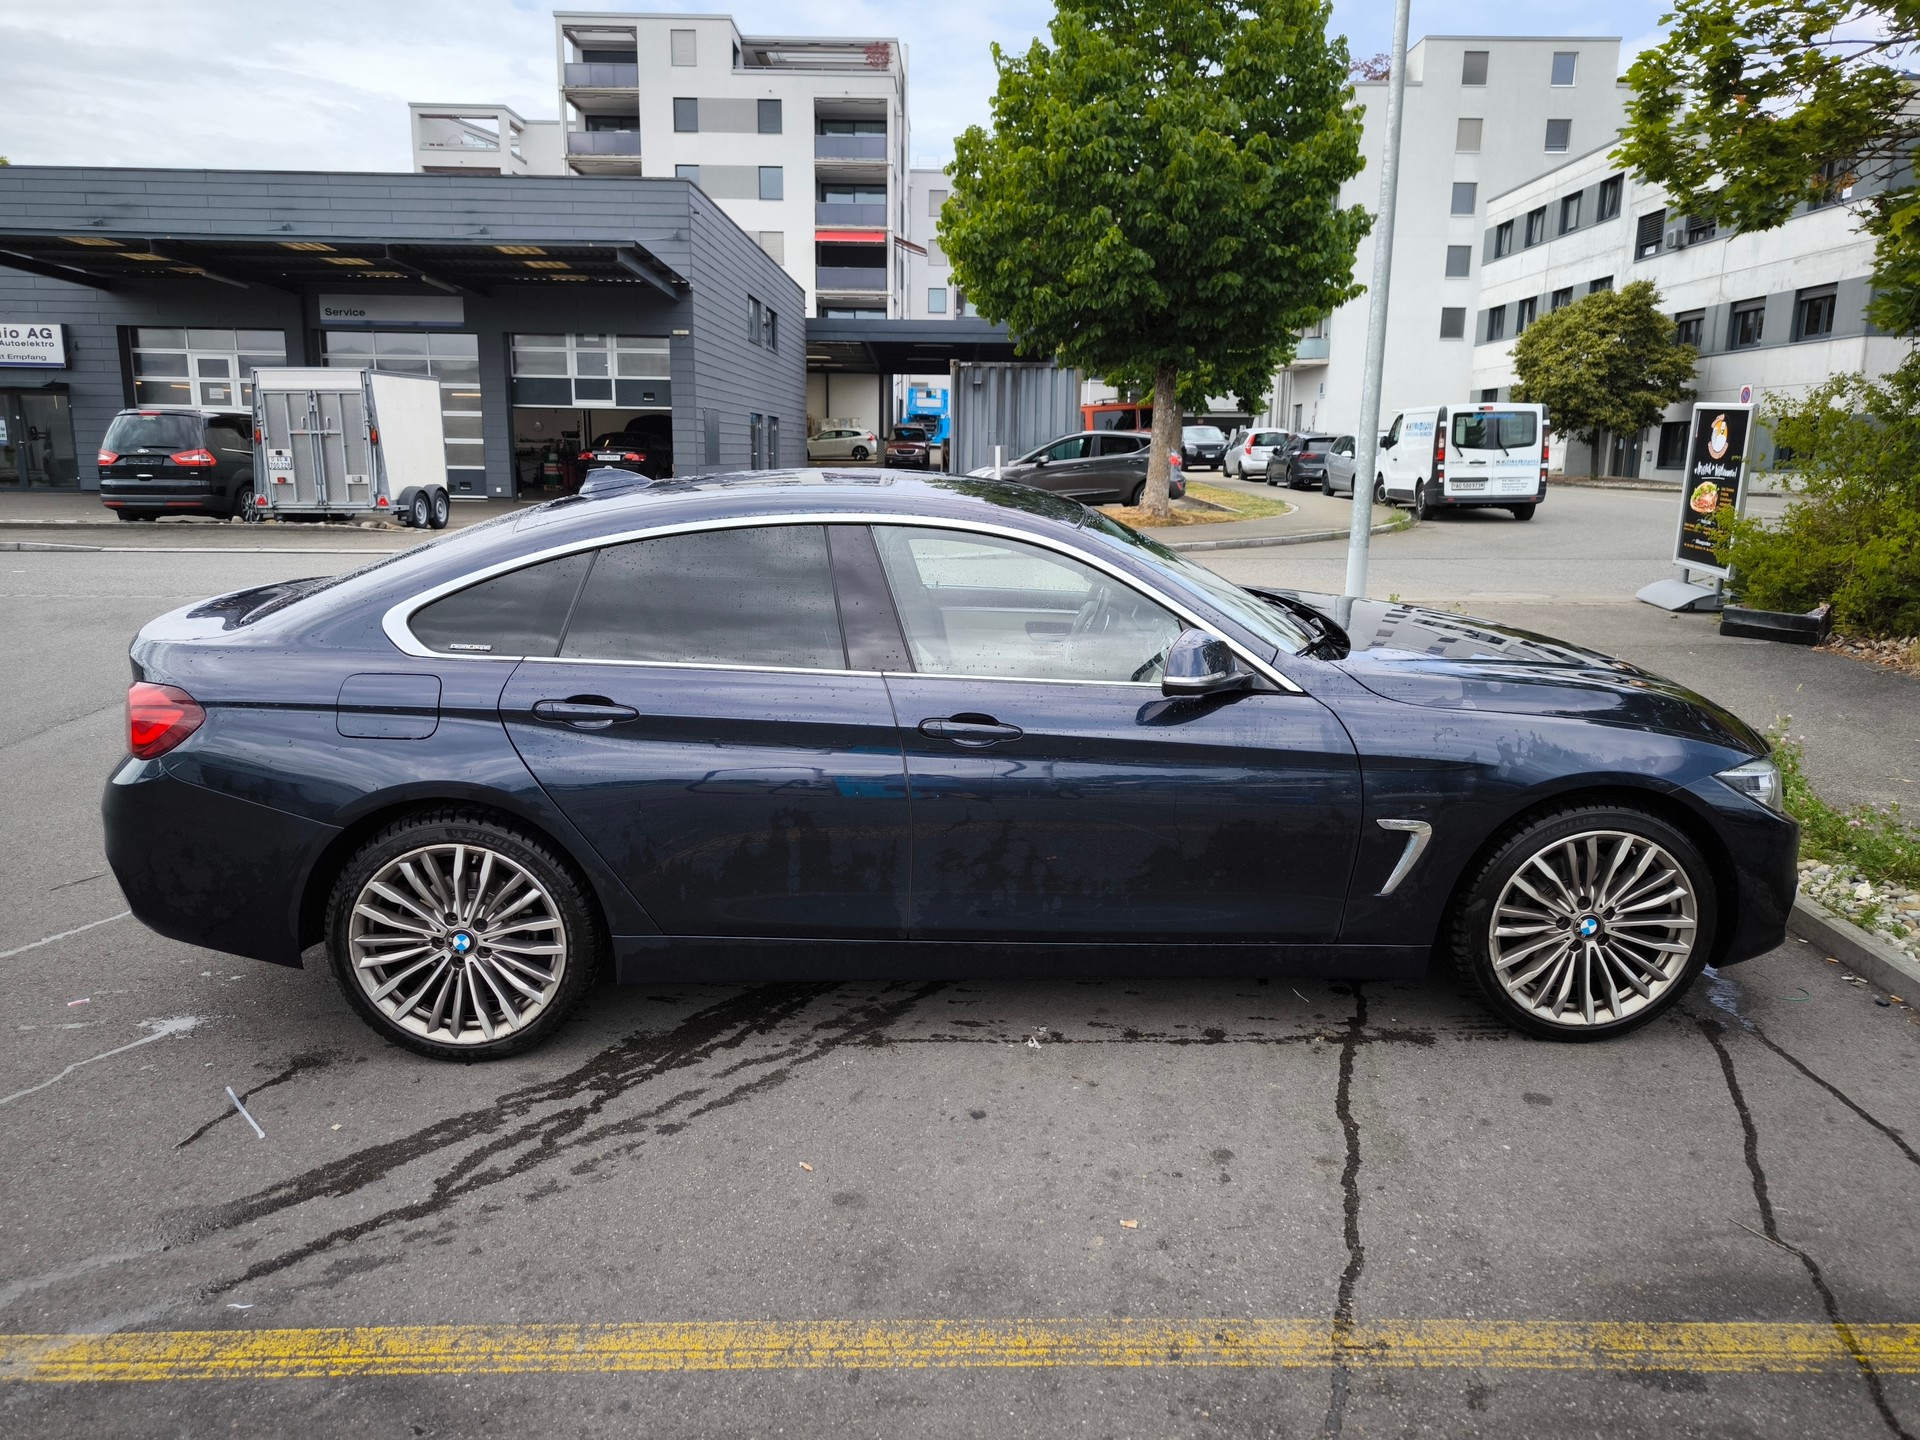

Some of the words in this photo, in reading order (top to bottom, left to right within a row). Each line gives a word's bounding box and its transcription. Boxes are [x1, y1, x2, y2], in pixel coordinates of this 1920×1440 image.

[325, 307, 366, 316] Service
[0, 327, 19, 339] io
[27, 327, 53, 339] AG
[0, 340, 55, 348] Autoelektro
[1536, 816, 1598, 841] MICHELIN
[466, 830, 534, 862] MICHELIN
